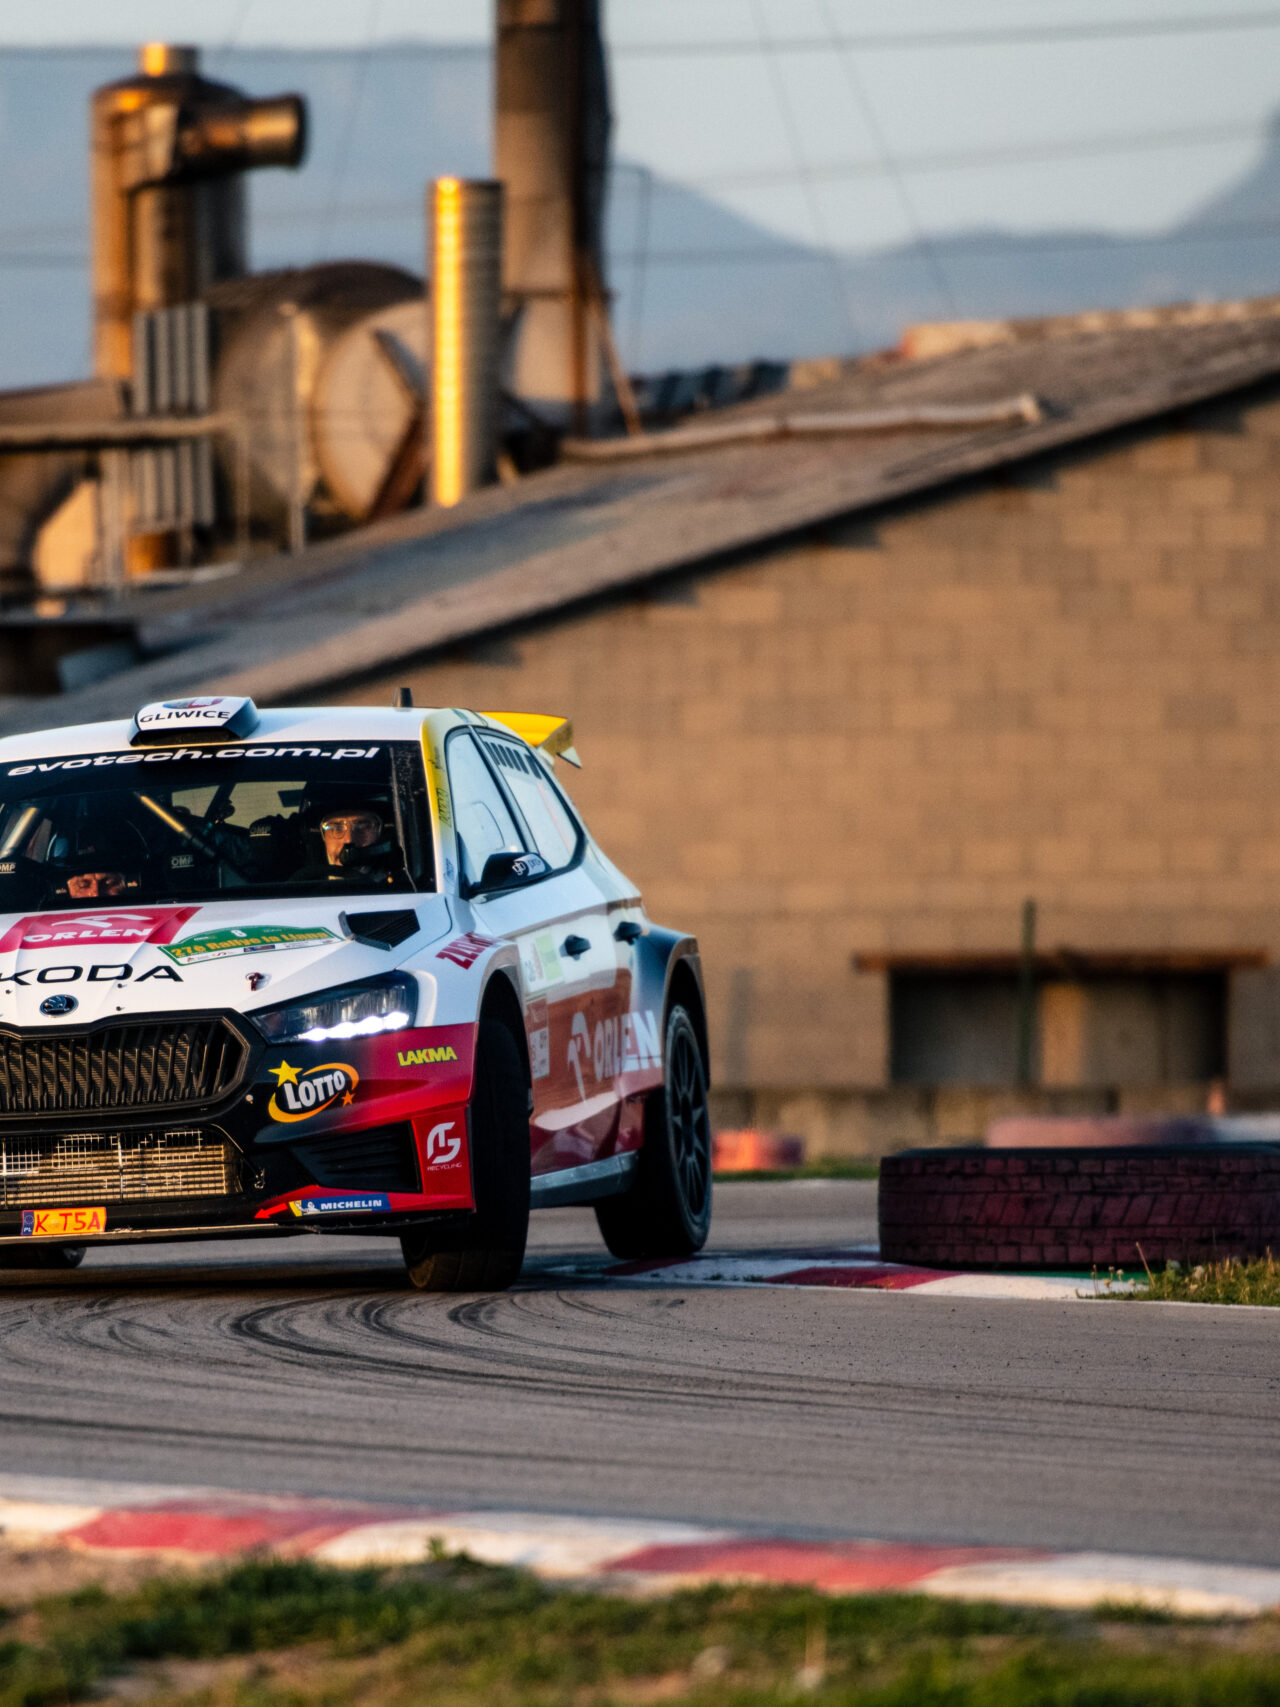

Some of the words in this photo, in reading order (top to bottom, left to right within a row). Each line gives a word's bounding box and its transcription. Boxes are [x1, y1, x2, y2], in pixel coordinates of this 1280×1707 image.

[140, 710, 231, 723] GLIWICE
[7, 746, 380, 777] evotech.com.pl
[172, 855, 194, 867] OMP
[22, 928, 153, 943] ORLEN
[593, 1010, 662, 1083] ORLEN
[397, 1046, 458, 1067] LAKMA
[283, 1070, 346, 1110] LOTTO
[427, 1162, 463, 1172] RECYCLING
[320, 1199, 382, 1211] MICHELIN
[35, 1213, 50, 1233] K
[59, 1211, 101, 1231] T5A
